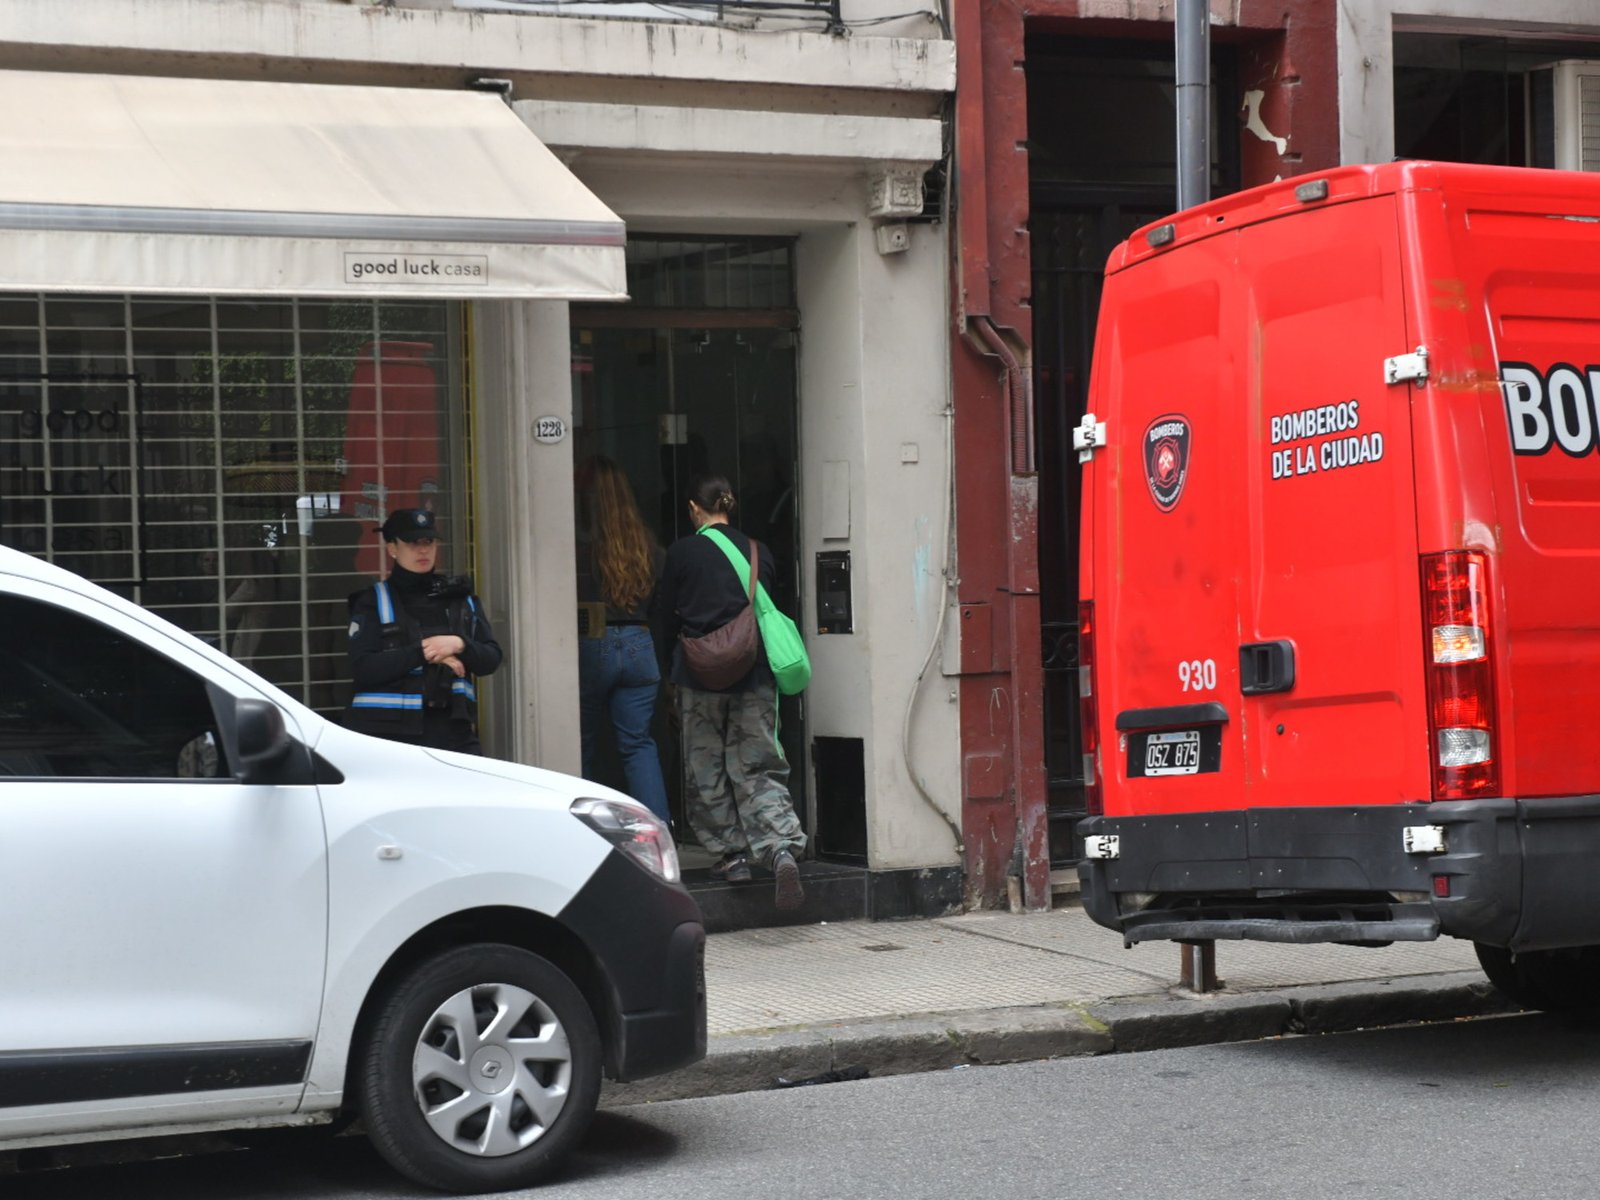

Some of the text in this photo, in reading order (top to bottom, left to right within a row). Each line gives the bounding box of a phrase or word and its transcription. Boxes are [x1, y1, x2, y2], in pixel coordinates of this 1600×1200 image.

[352, 258, 481, 278] good luck casa
[1271, 400, 1359, 444] BOMBEROS
[1500, 363, 1600, 455] BO
[537, 421, 562, 437] 1228
[1149, 423, 1184, 442] BOMBEROS
[1272, 432, 1383, 479] DE LA CIUDAD
[1178, 659, 1216, 692] 930
[1147, 742, 1197, 767] OSZ 875
